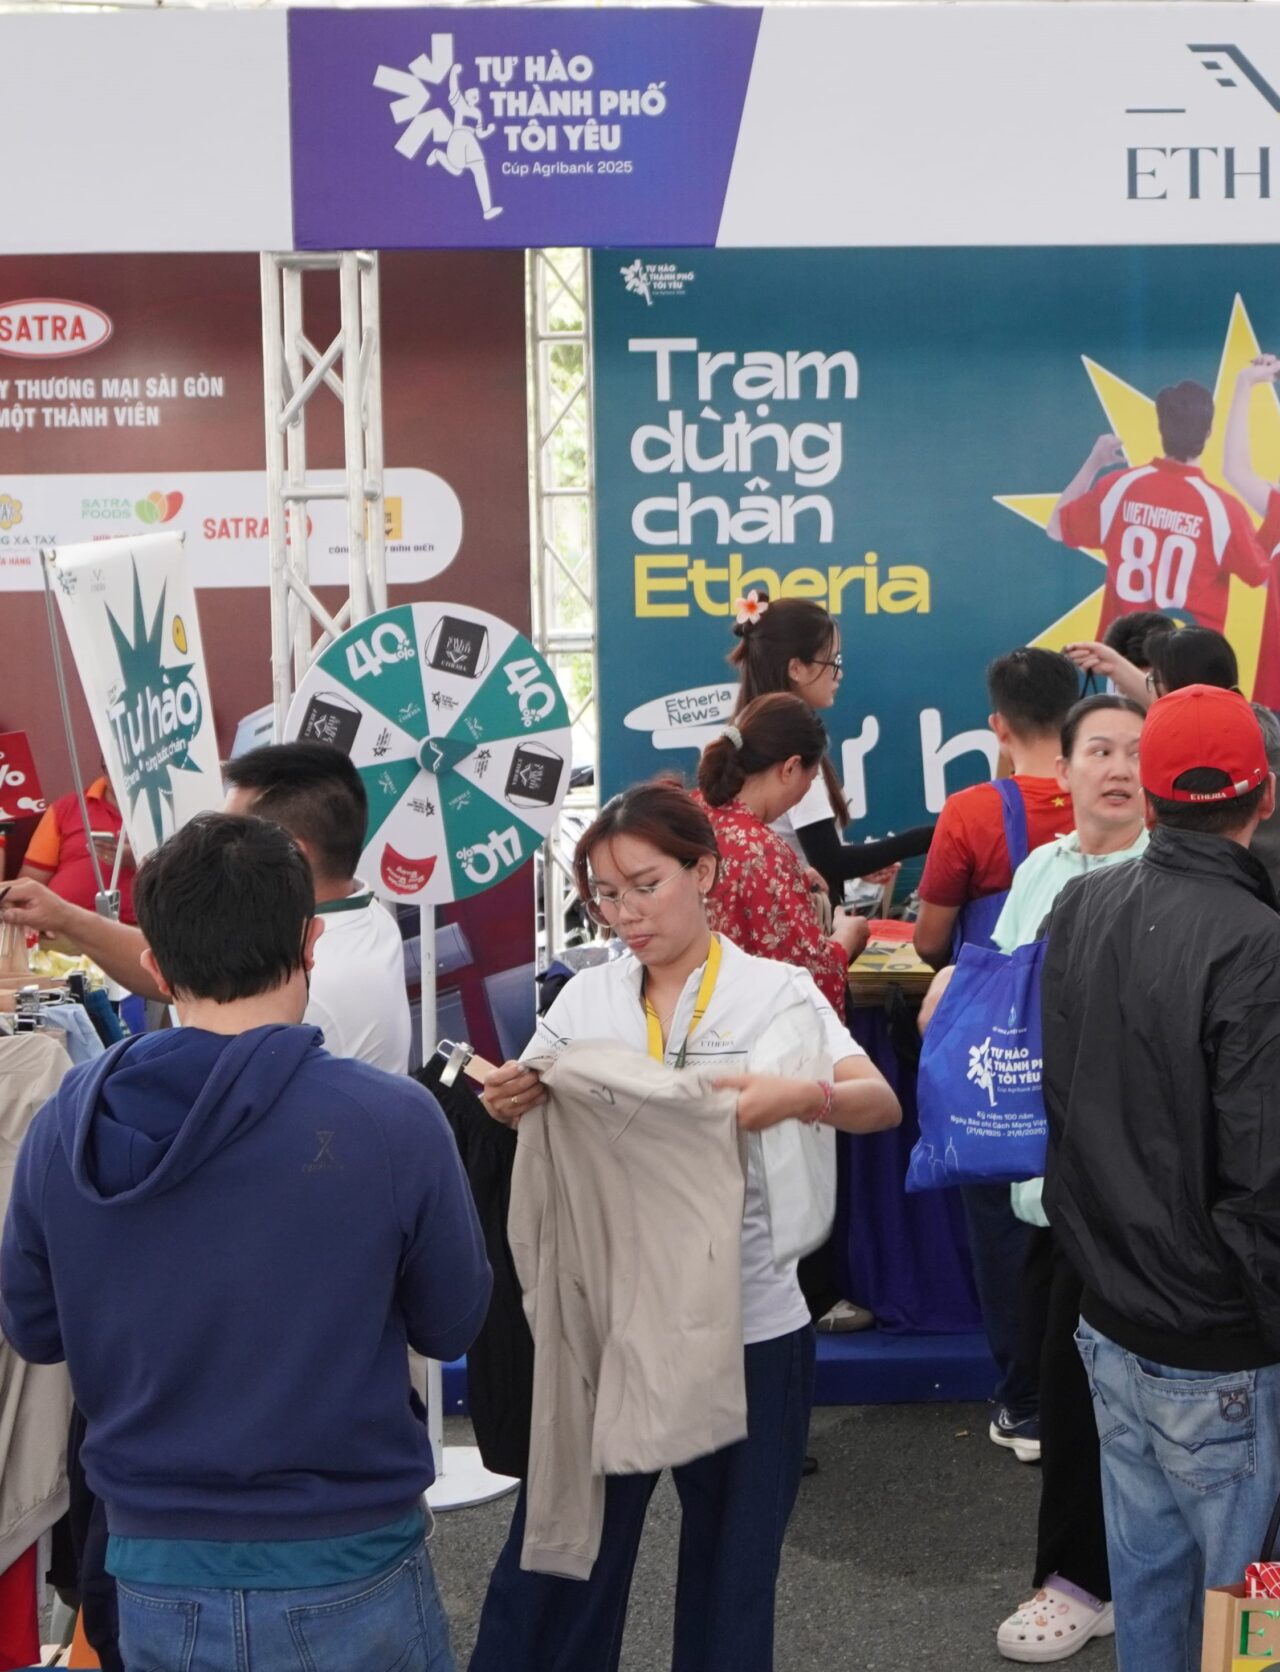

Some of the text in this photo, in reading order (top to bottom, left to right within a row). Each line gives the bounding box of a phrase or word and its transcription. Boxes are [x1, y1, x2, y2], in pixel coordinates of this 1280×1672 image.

[475, 49, 594, 88] TỰ HÀO
[489, 81, 667, 116] THÀNH PHỐ
[503, 118, 622, 151] TÔI YÊU
[502, 160, 633, 177] Cúp Agribank 2025
[0, 315, 87, 341] SATRA
[15, 376, 96, 400] THƯƠNG
[102, 377, 140, 402] MẠI
[146, 373, 177, 398] SÀI
[183, 371, 224, 397] GÒN
[42, 402, 108, 427] THÀNH
[114, 402, 160, 426] VIÊN
[630, 405, 843, 487] dừng
[81, 499, 132, 509] SATRA
[81, 509, 131, 519] FOODS
[631, 475, 834, 545] chân
[202, 517, 270, 540] SATRA
[1122, 499, 1204, 539] VIETNAMESE
[33, 535, 57, 545] TAX
[1116, 525, 1197, 610] 80
[633, 551, 930, 618] Etheria
[665, 689, 732, 713] Etheria
[668, 706, 720, 727] News
[1190, 792, 1227, 801] ETHERIA
[1004, 1046, 1029, 1060] HÀO
[993, 1060, 1030, 1072] THÀNH
[998, 1070, 1041, 1085] TÔI YÊU
